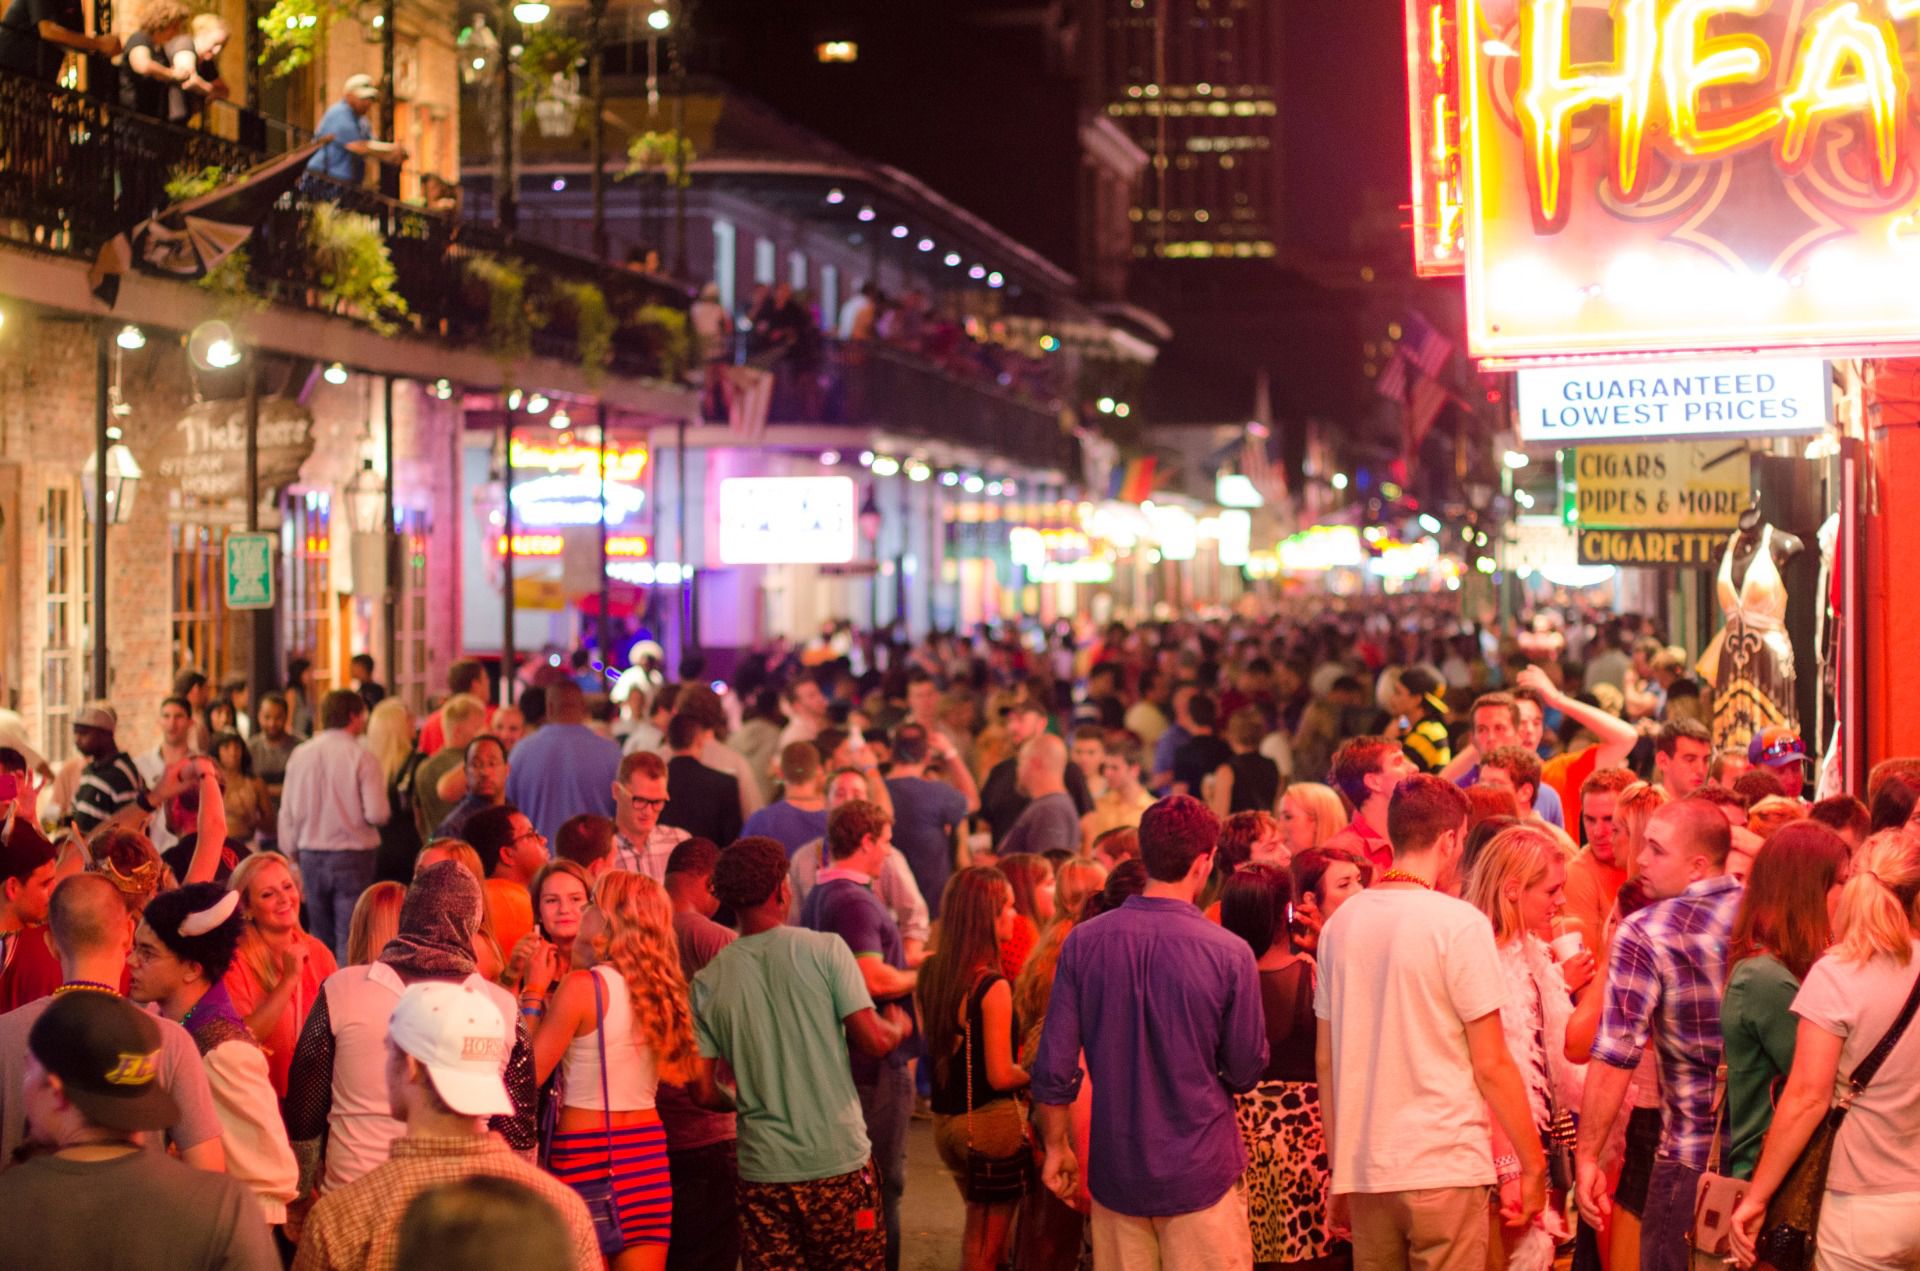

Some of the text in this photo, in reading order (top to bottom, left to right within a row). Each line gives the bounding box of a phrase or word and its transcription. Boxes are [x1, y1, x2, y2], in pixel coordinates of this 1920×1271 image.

[1515, 0, 1920, 236] HEA
[1562, 373, 1776, 401] GUARANTEED
[1542, 398, 1798, 427] LOWEST PRICES
[1581, 453, 1667, 479] CIGARS
[1580, 487, 1742, 514] PIPES & MORE
